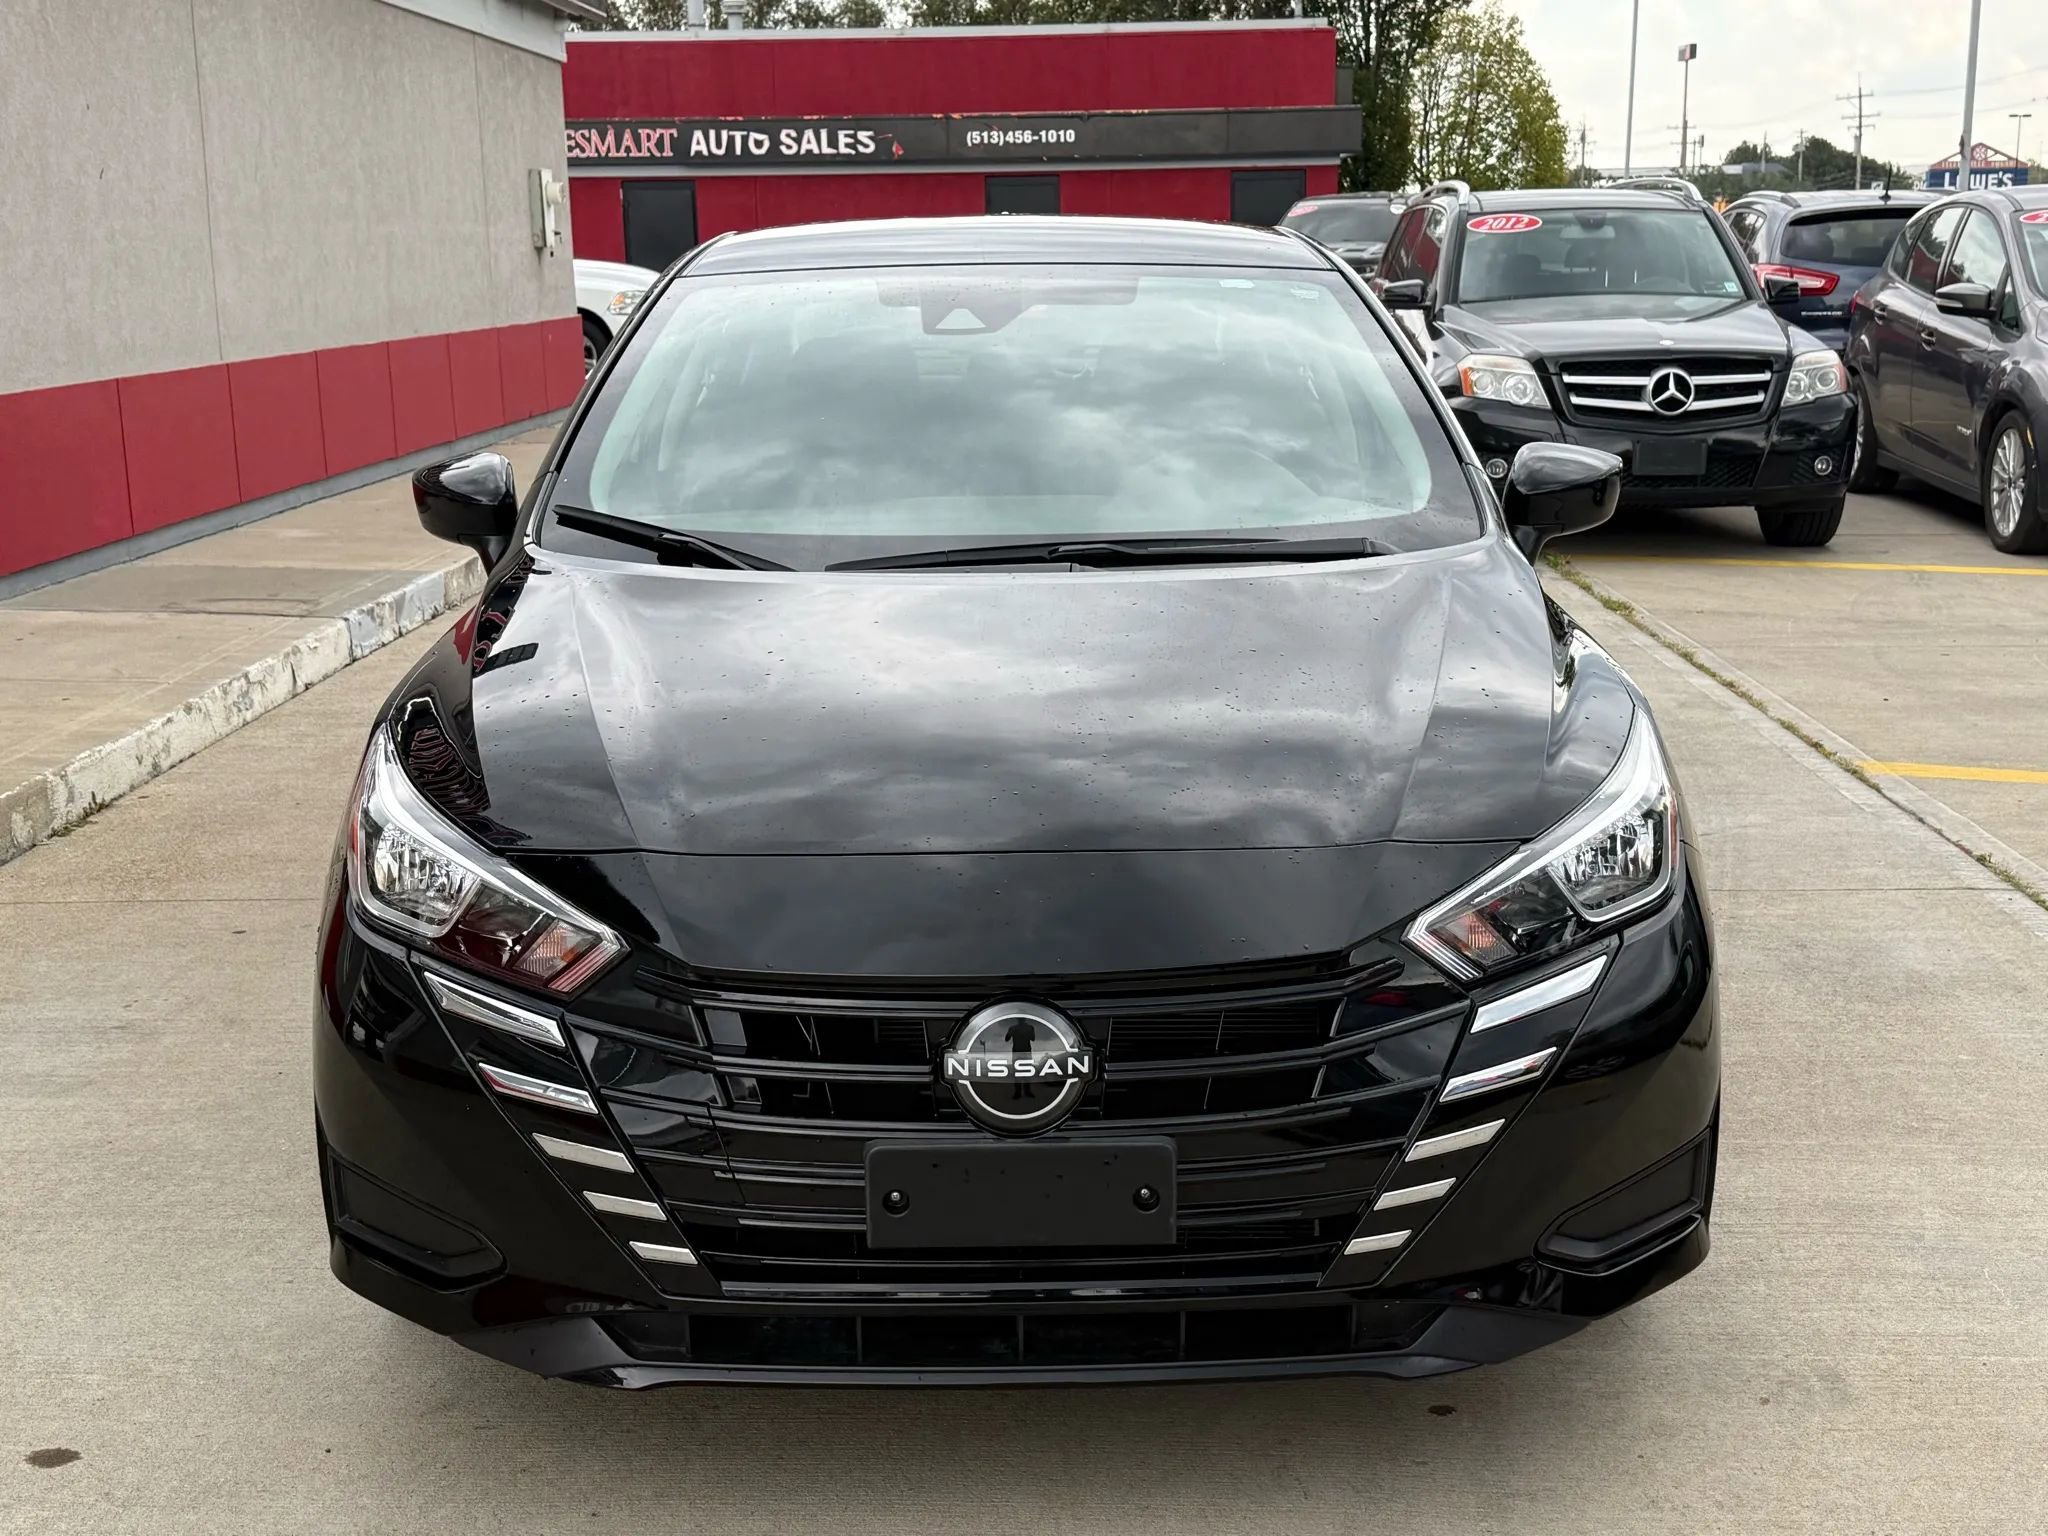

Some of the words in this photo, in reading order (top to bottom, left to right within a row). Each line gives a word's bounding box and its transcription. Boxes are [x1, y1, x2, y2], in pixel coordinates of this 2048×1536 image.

[690, 128, 770, 157] AUTO
[779, 128, 876, 156] SALES
[966, 129, 1076, 147] (513)456-1010
[1944, 171, 2013, 191] LWE'S
[1480, 217, 1529, 229] 2012
[947, 1055, 1089, 1077] NISSAN
